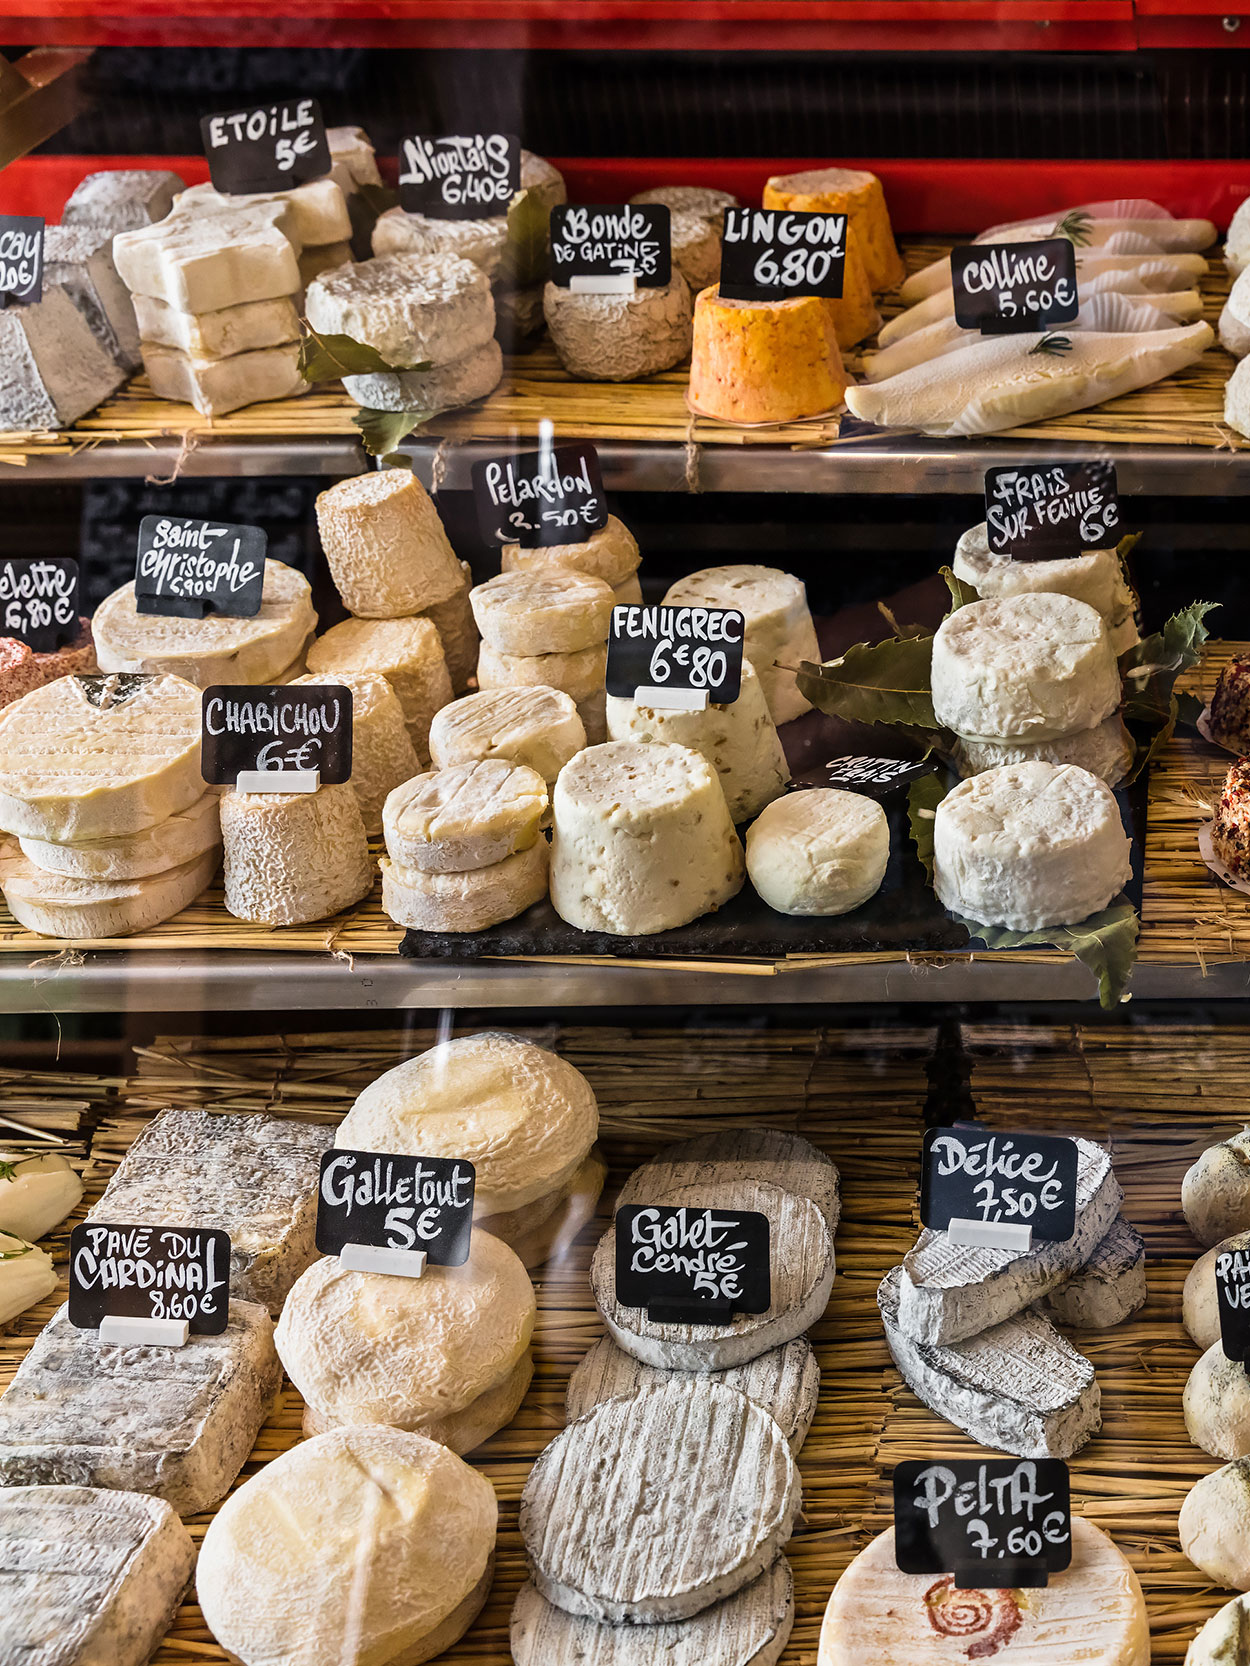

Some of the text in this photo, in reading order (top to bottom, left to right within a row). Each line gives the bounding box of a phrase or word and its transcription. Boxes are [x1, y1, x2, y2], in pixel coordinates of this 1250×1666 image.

[276, 131, 318, 171] 5€
[442, 174, 514, 205] 6,40€
[562, 204, 652, 244] Bonde
[553, 243, 576, 263] DE
[610, 258, 659, 278] 7€
[753, 246, 845, 287] 6,80€
[987, 504, 1034, 549] SUR
[1079, 502, 1120, 543] 6€
[141, 538, 261, 596] Christophe
[5, 597, 75, 634] 6,80€
[612, 605, 743, 644] FENUGREC
[649, 639, 729, 689] 6€80
[255, 738, 323, 772] 6€
[930, 1136, 1059, 1183] Délice
[972, 1179, 1066, 1223] 7,50€
[160, 1232, 201, 1260] DU
[384, 1207, 444, 1250] 5€
[631, 1207, 741, 1253] Galet
[630, 1241, 750, 1279] Cendré
[149, 1290, 218, 1320] 8,60€
[692, 1270, 745, 1301] 5€
